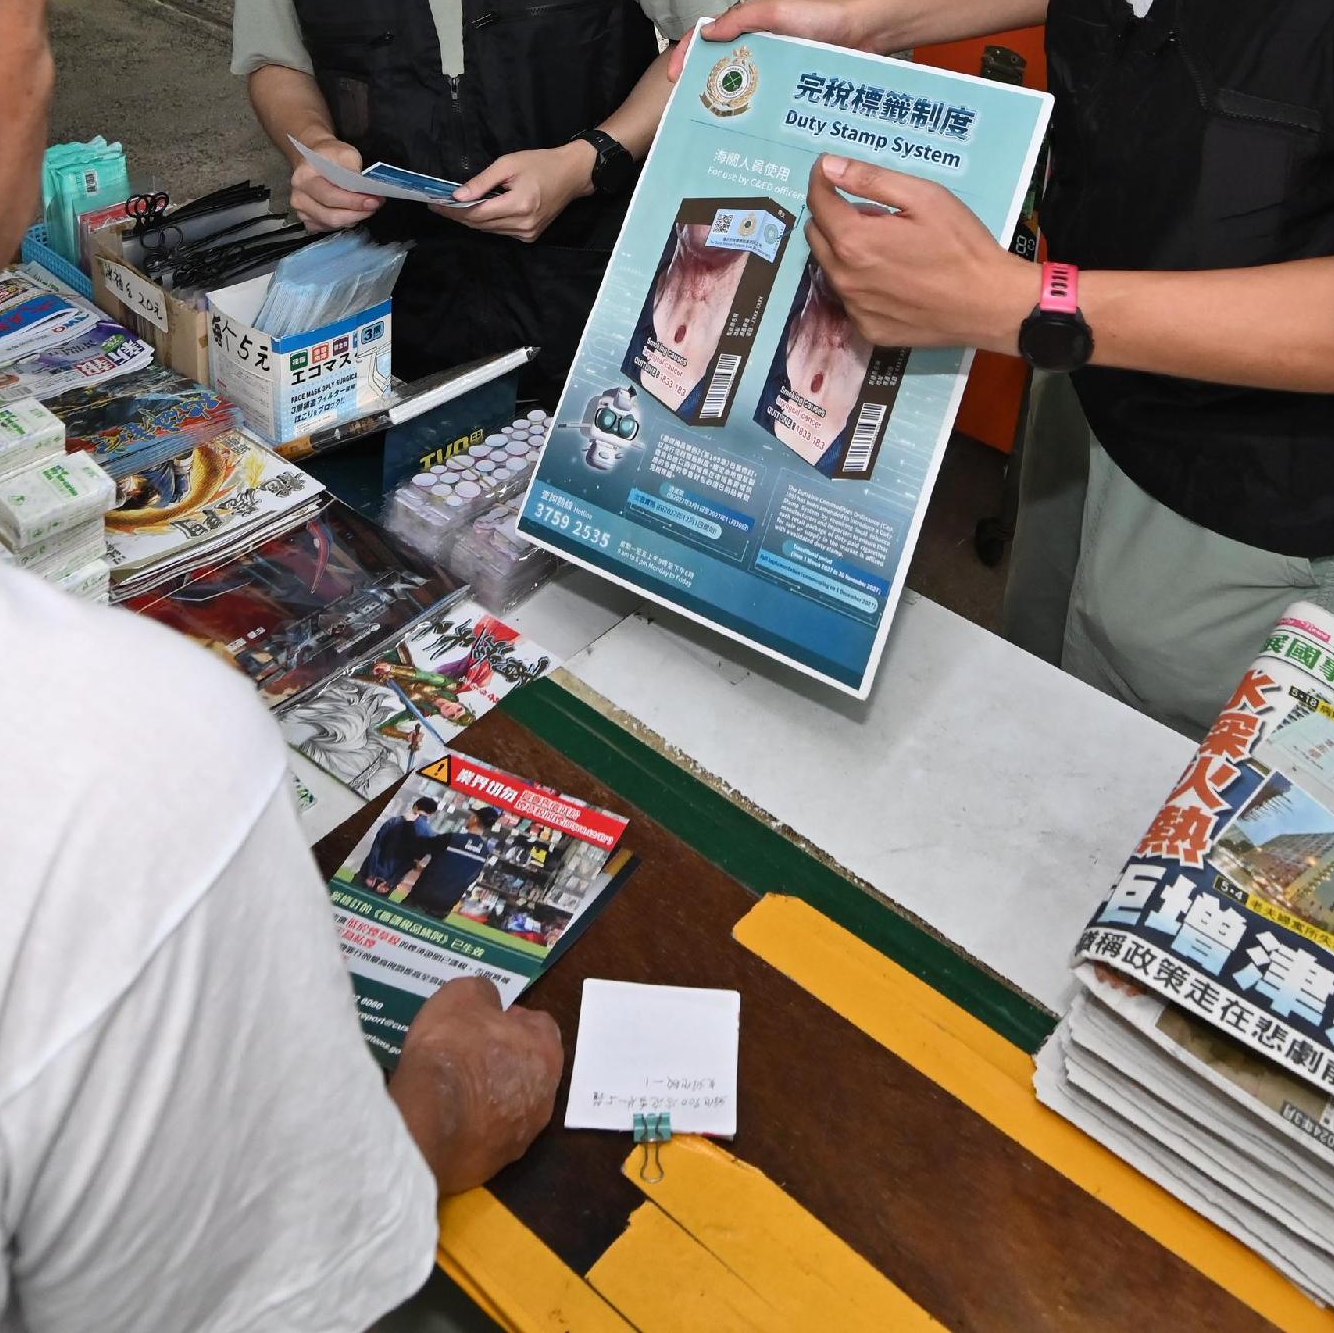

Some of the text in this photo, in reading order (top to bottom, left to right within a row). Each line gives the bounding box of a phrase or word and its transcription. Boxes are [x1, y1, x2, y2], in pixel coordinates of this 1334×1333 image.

[793, 69, 976, 141] 完稅標籤制度
[783, 108, 962, 172] Duty Stamp System
[713, 148, 791, 181] 海關人員使用
[707, 166, 806, 201] For use by C&ED officers
[77, 338, 146, 378] 新報
[290, 352, 358, 386] エコマス
[290, 392, 306, 404] FACE
[307, 386, 321, 400] MASK
[778, 385, 828, 418] Smoking causes
[170, 470, 307, 540] 龍虎門
[572, 506, 593, 520] Hotline
[533, 502, 611, 548] 3759 2535
[453, 768, 521, 802] 業界切勿
